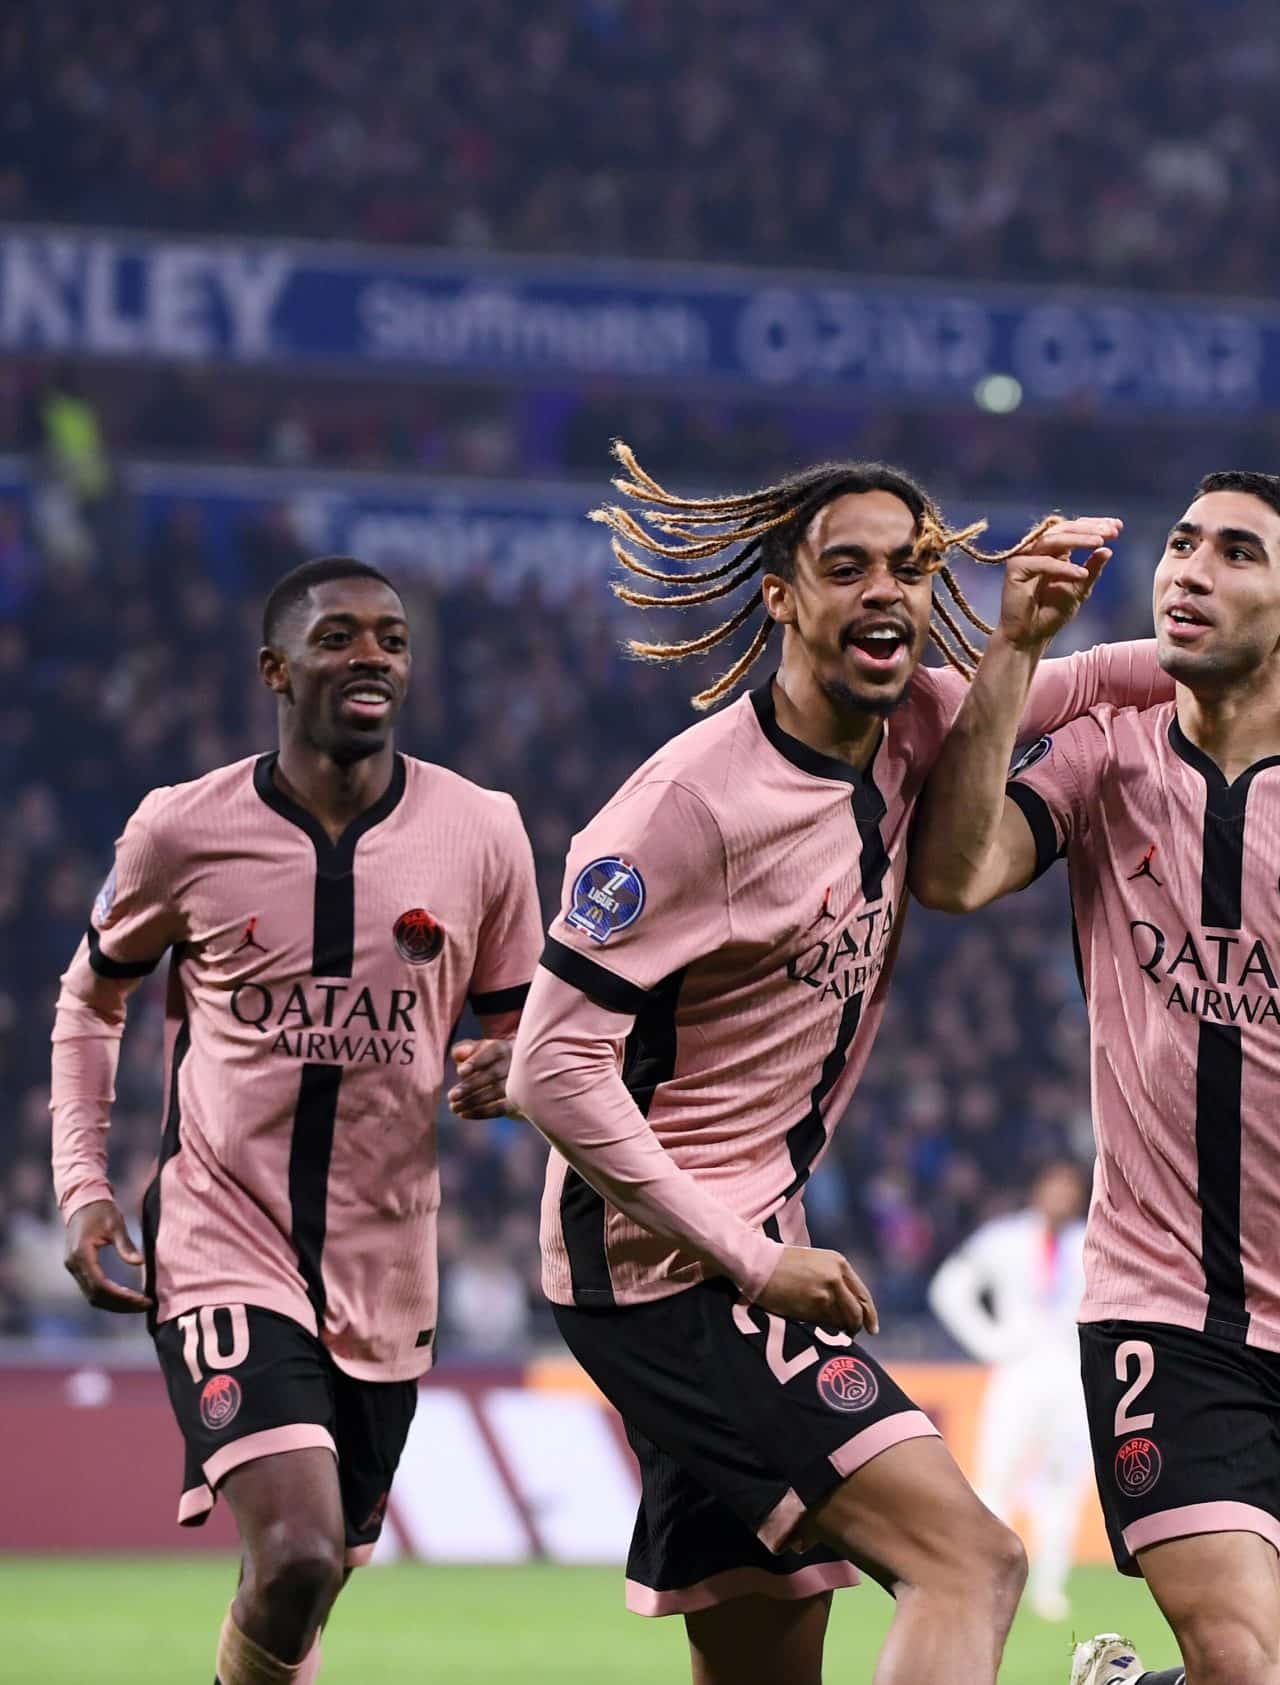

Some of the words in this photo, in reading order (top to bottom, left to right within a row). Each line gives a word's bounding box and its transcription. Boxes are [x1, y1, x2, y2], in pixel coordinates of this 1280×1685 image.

[786, 900, 894, 988] QATA
[230, 983, 417, 1034] QATAR
[271, 1030, 416, 1065] AIRWAYS
[178, 1303, 250, 1383] 10
[821, 1359, 855, 1382] PARIS
[1113, 1340, 1155, 1436] 2
[1119, 1441, 1151, 1460] PARIS
